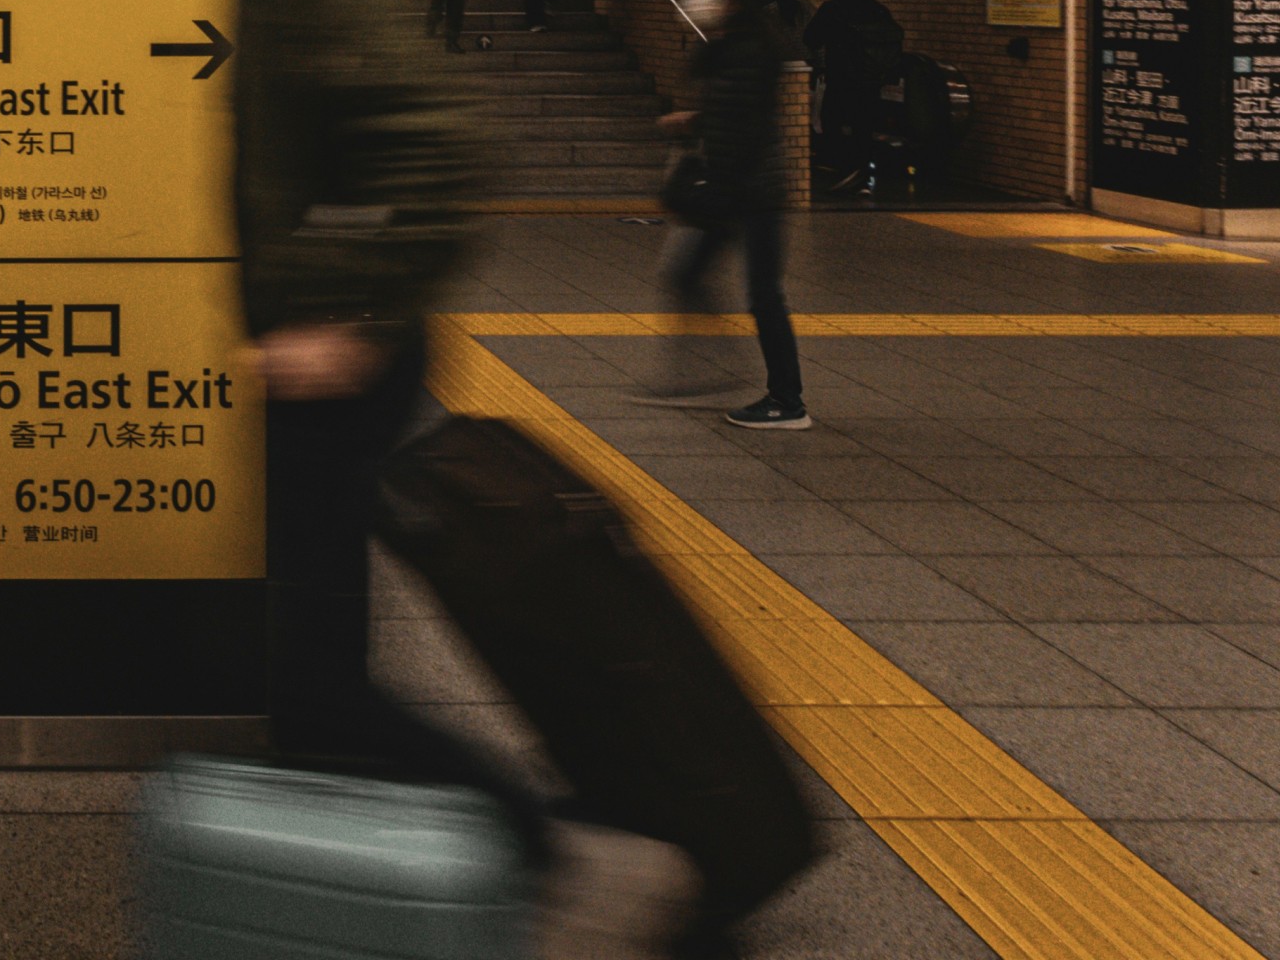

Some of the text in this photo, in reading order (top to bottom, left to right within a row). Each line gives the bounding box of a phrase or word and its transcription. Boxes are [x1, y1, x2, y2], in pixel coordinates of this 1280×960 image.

[61, 79, 125, 116] Exit
[38, 370, 132, 410] East
[147, 367, 233, 410] Exit
[9, 420, 67, 449] 출구
[86, 420, 204, 449] 八条东口
[15, 478, 216, 513] 6:50-23:00
[23, 525, 98, 543] 营业时间
